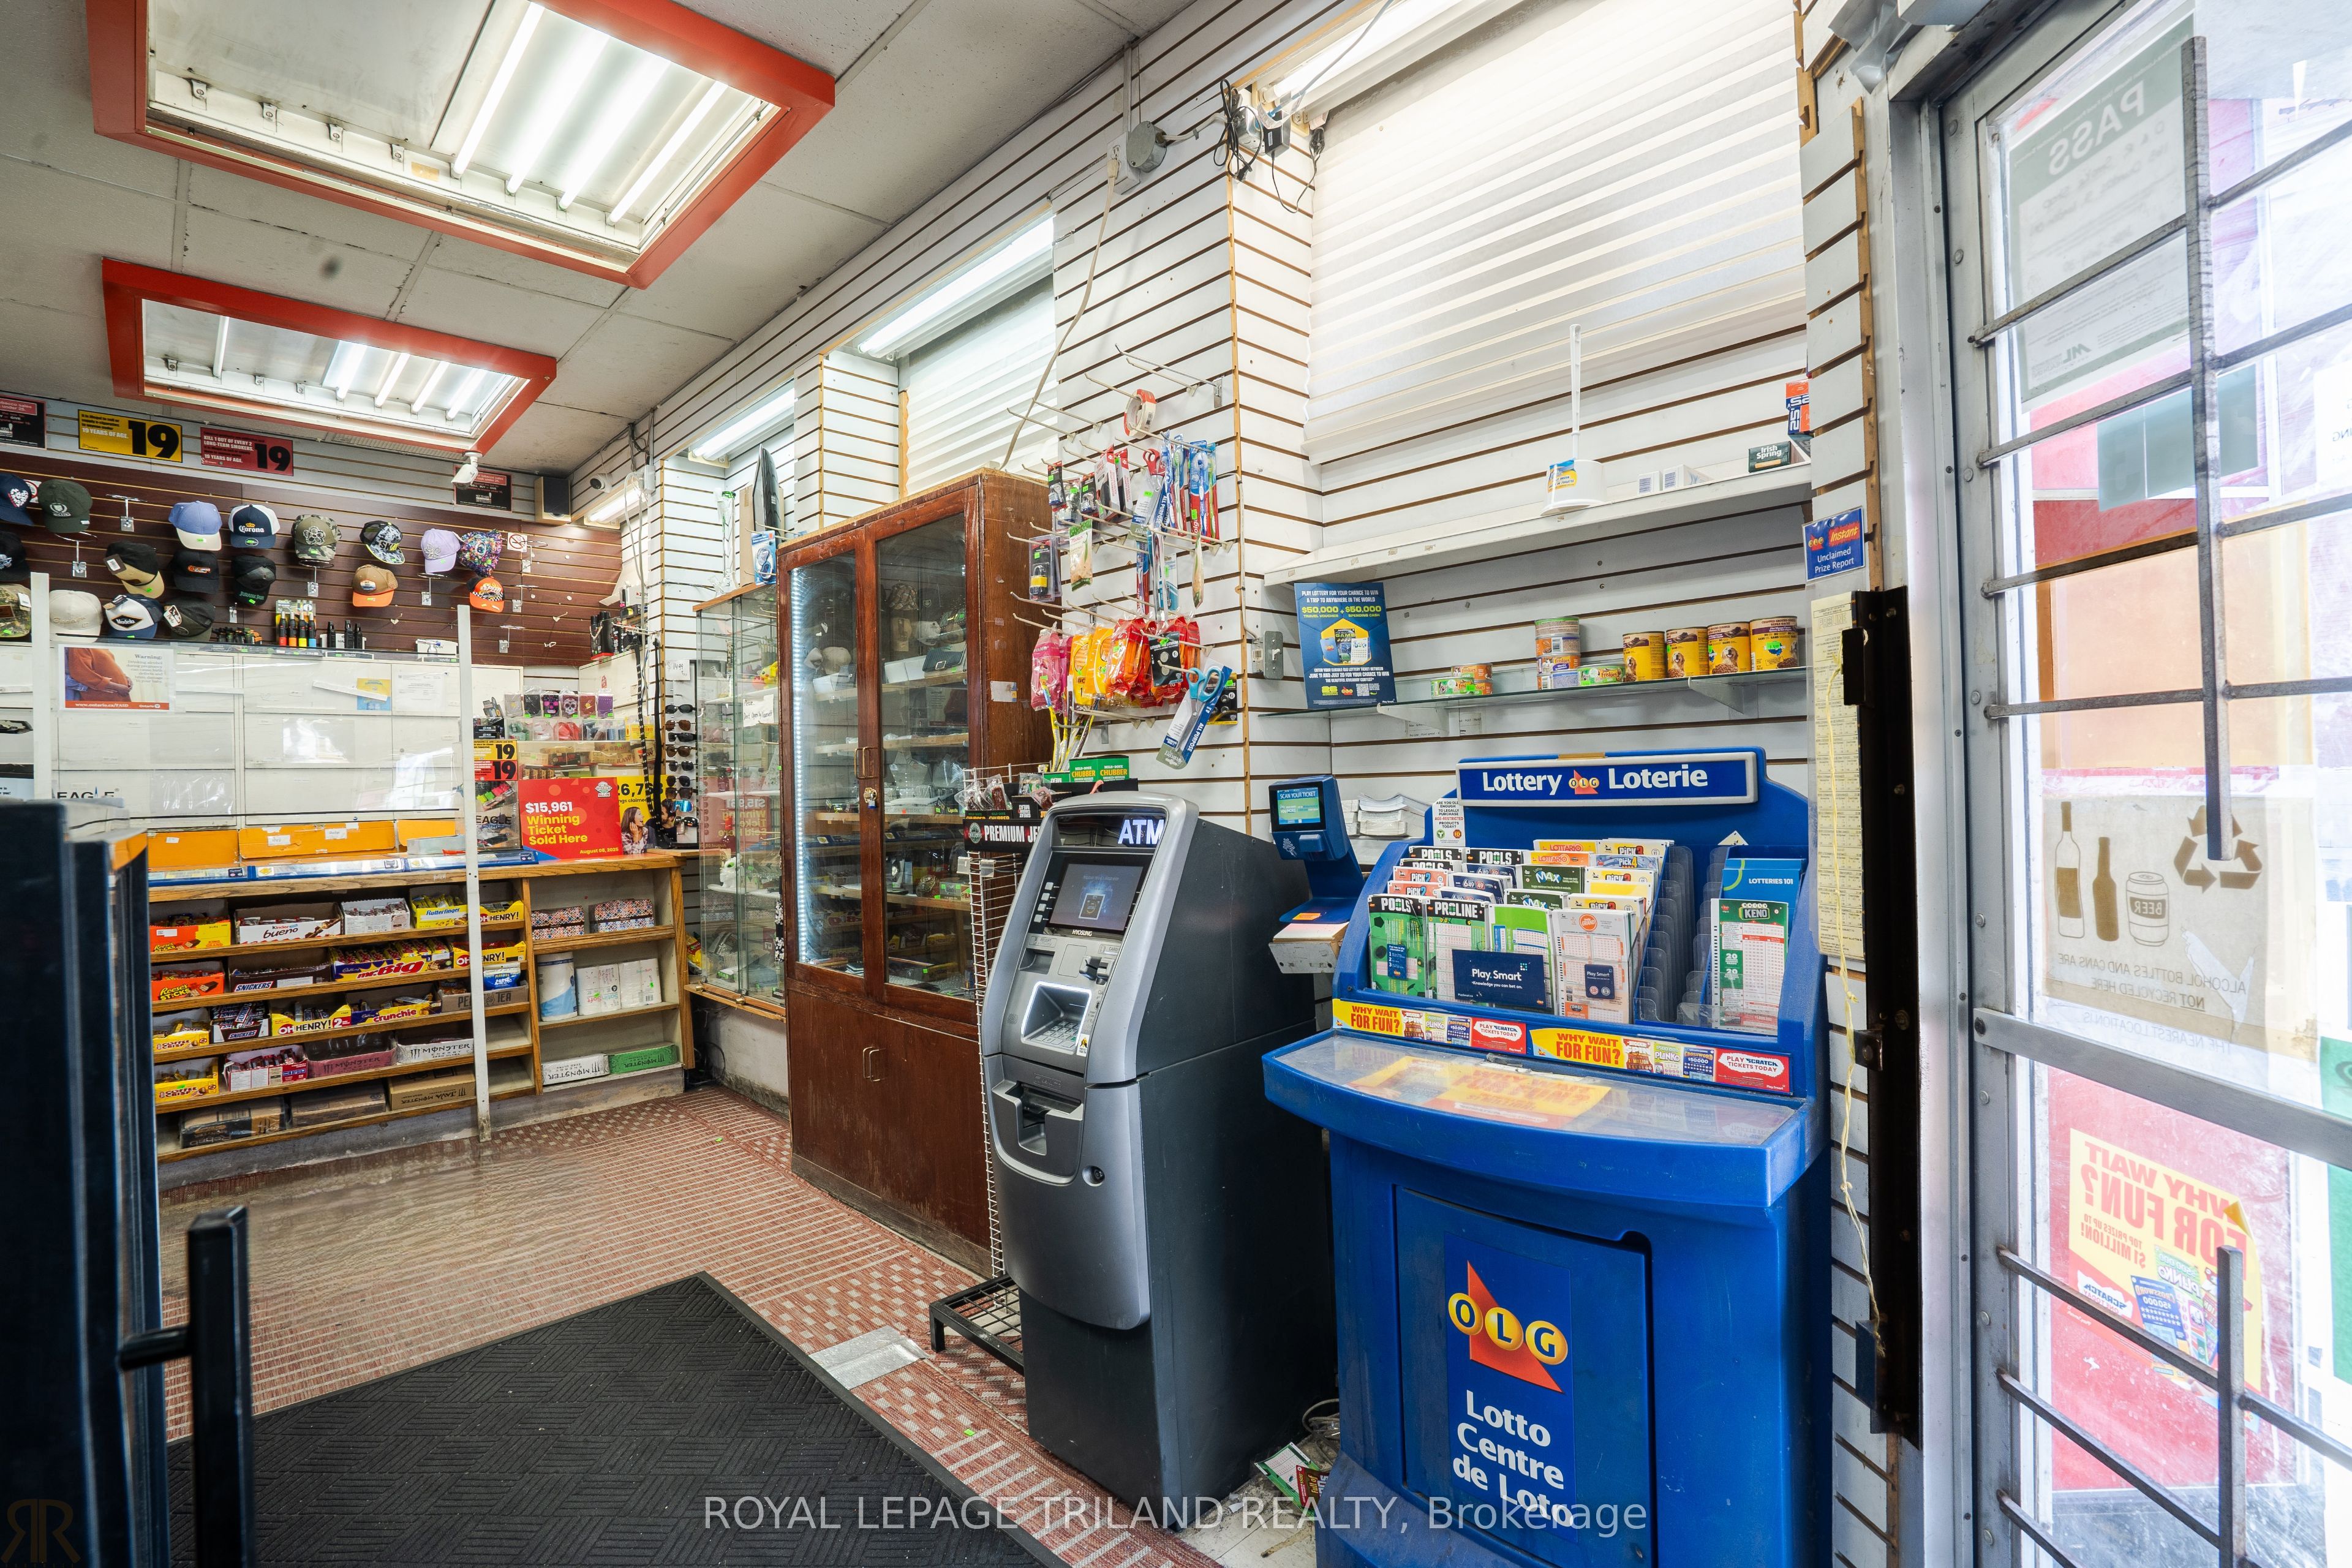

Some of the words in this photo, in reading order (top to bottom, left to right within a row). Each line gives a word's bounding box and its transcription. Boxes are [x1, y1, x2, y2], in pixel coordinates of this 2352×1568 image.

[128, 420, 179, 459] 19
[1756, 449, 1782, 461] Spring
[1761, 445, 1778, 454] Irish
[255, 443, 290, 471] 19
[239, 525, 265, 533] Corona
[1809, 537, 1823, 548] OLG
[1830, 526, 1858, 543] Instant
[1818, 548, 1852, 563] Unclaimed
[1815, 562, 1836, 573] Prize
[1837, 557, 1854, 571] Report
[1187, 731, 1202, 752] PURPOSE
[496, 744, 514, 760] 19
[492, 761, 516, 780] 19
[1482, 771, 1563, 796] Lottery
[1569, 777, 1599, 788] OLG
[1609, 764, 1708, 790] Loterie
[525, 801, 573, 814] $15,961
[527, 814, 580, 826] Winning
[527, 824, 567, 835] Ticket
[984, 825, 1025, 843] PREMIUM
[1118, 819, 1164, 845] ATM
[529, 835, 557, 845] Sold
[559, 834, 588, 844] Here
[1421, 849, 1452, 860] POOLS
[1479, 851, 1512, 865] POOLS
[426, 907, 461, 916] Butterfinger
[1381, 897, 1412, 913] POOLS
[1434, 902, 1479, 919] PROLINE
[489, 912, 519, 921] HENRY!
[1744, 908, 1768, 919] KENO
[263, 927, 298, 939] bueno
[1493, 970, 1522, 981] Smart
[235, 981, 273, 992] SNICKERS
[497, 992, 511, 1002] TEA
[373, 1008, 417, 1023] crunchie
[1352, 1005, 1373, 1014] WHY
[1375, 1008, 1398, 1018] WAIT
[279, 1025, 295, 1035] OH
[296, 1016, 331, 1031] HENRY!
[1351, 1013, 1370, 1030] FOR
[1373, 1016, 1400, 1034] FUN?
[228, 1030, 257, 1039] SNICKERS
[1556, 1033, 1586, 1042] WHY
[1588, 1035, 1619, 1047] WAIT
[422, 1042, 470, 1054] MONSTER
[1556, 1041, 1582, 1059] FOR
[1585, 1045, 1621, 1066] FUN?
[1655, 1051, 1680, 1062] PLINKO
[1684, 1051, 1713, 1060] CROSSWORD
[335, 1057, 380, 1069] MONSTER
[1728, 1061, 1754, 1070] TICKETS
[1755, 1064, 1777, 1073] TODAY
[1745, 1057, 1779, 1068] SCRATCH
[548, 1067, 591, 1080] MONSTER
[402, 1096, 432, 1104] MONSTER
[432, 1091, 457, 1100] JAVA
[1452, 1295, 1561, 1362] OLG
[1466, 1389, 1551, 1447] Lotto
[1457, 1422, 1564, 1490] Centre
[1309, 1482, 1318, 1493] Full
[1453, 1454, 1488, 1491] de
[1499, 1473, 1574, 1528] Loto
